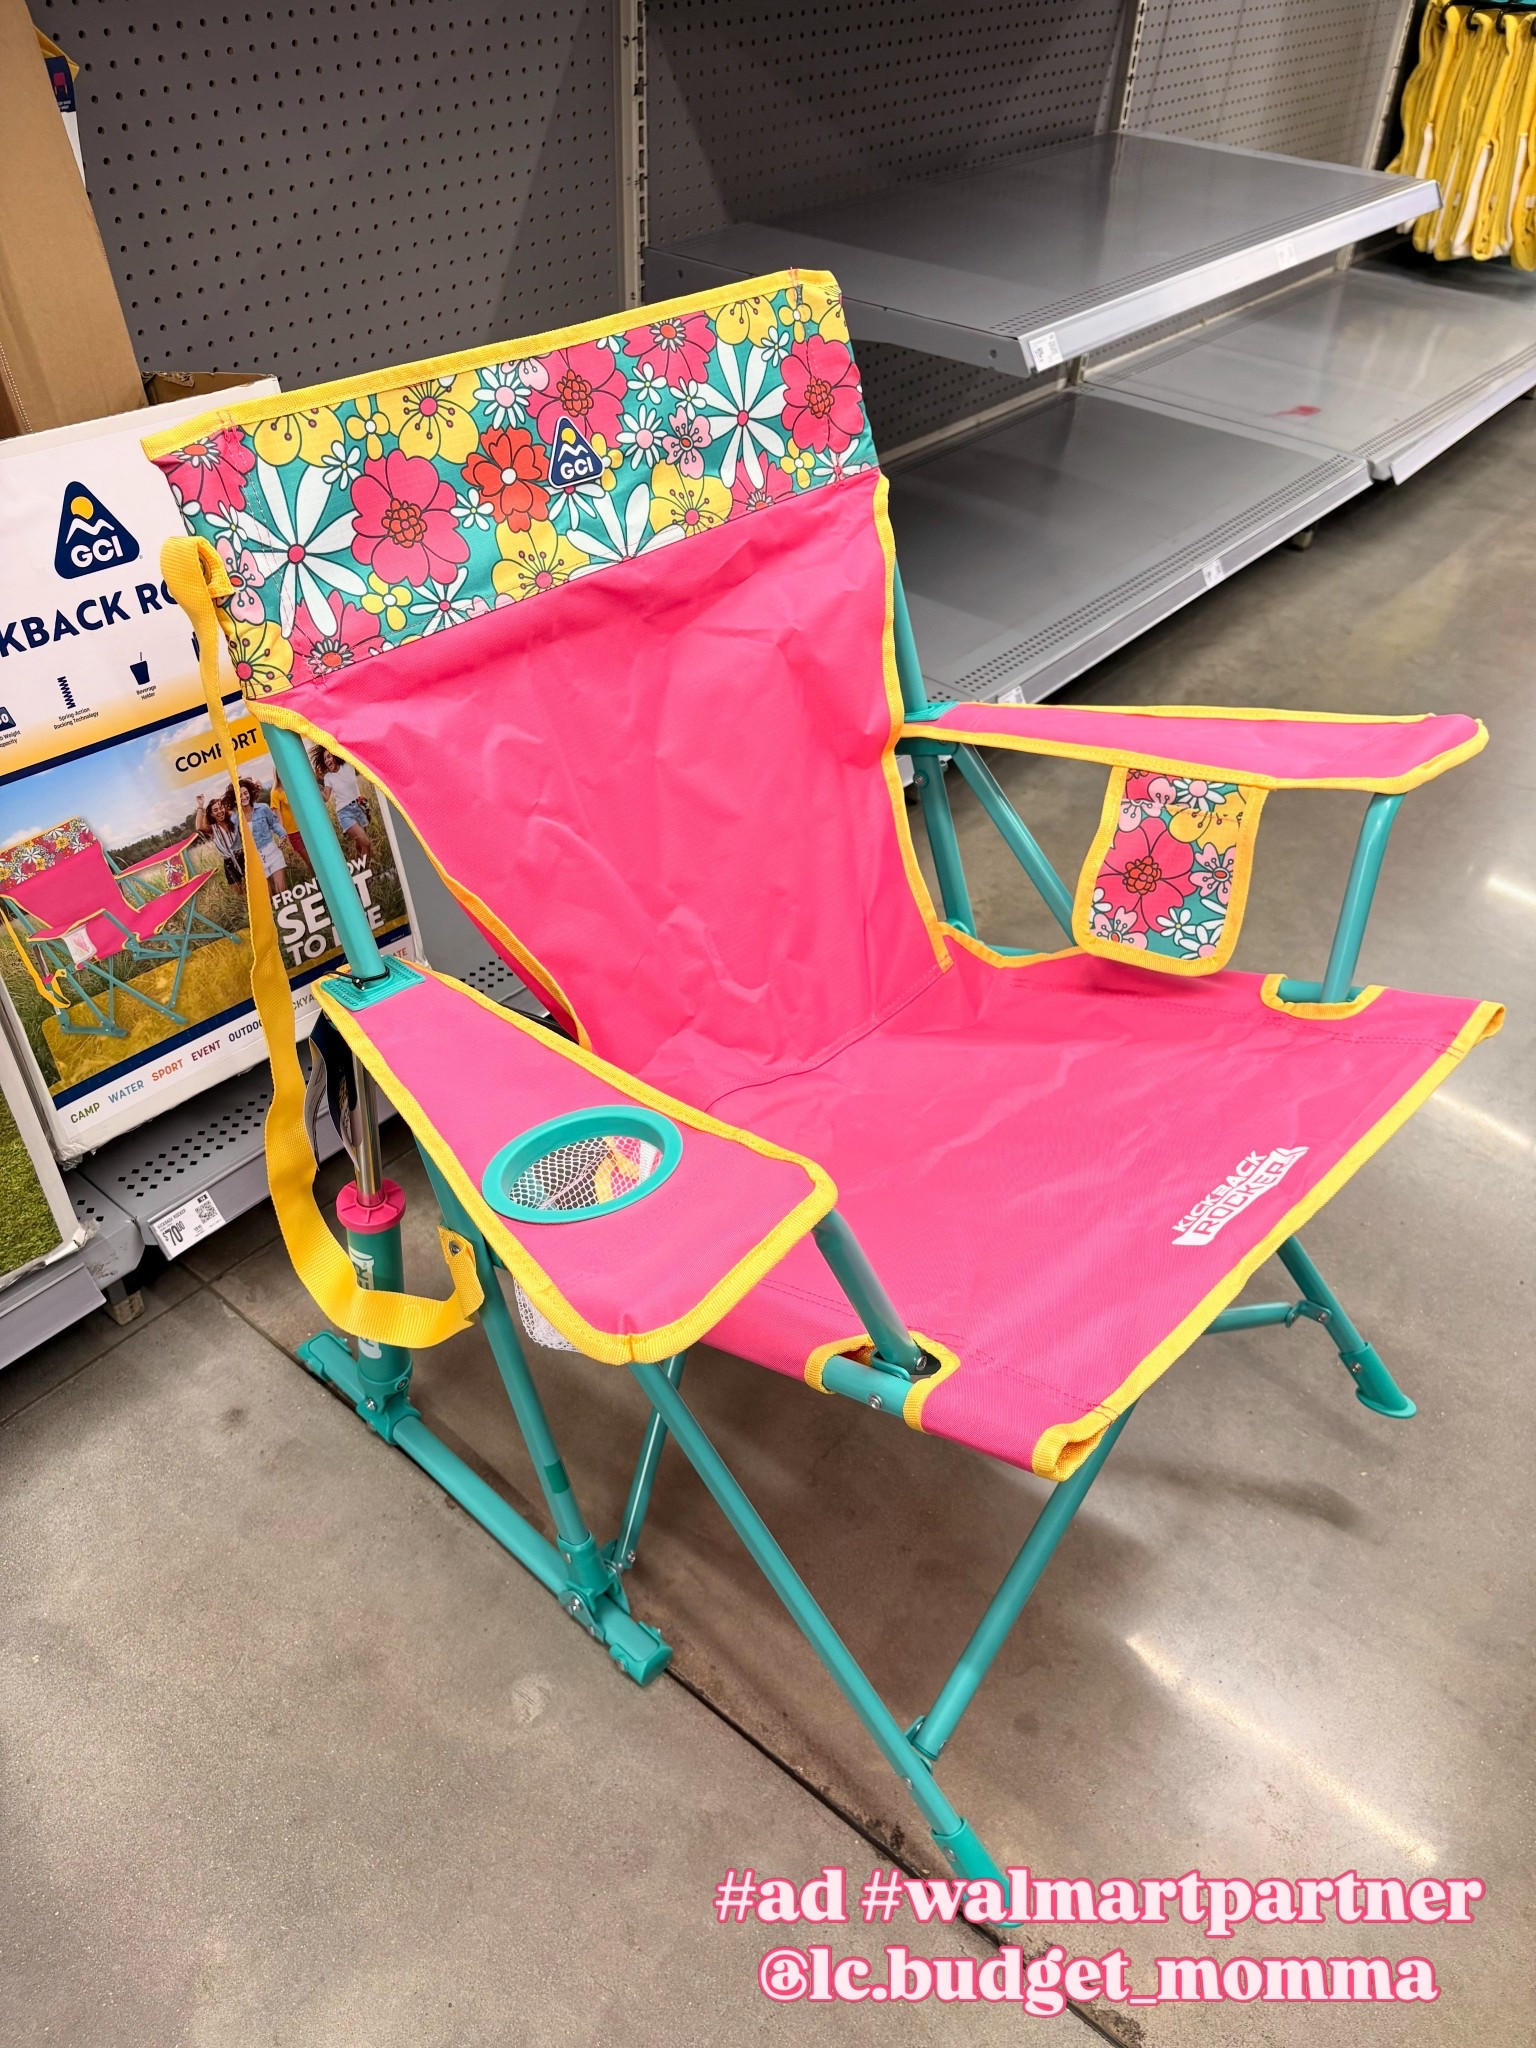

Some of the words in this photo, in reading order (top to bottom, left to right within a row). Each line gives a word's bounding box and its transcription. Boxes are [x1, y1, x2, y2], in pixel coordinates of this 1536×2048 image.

[560, 456, 594, 480] GCI
[70, 535, 124, 568] GCI
[136, 685, 157, 695] Beverage
[141, 692, 155, 700] Holder
[53, 719, 73, 730] Rocking
[73, 711, 99, 724] Technology
[58, 707, 90, 721] Spring-Action
[4, 730, 21, 739] Weight
[272, 877, 320, 910] FRON
[277, 869, 373, 945] SET
[287, 934, 327, 966] TO
[70, 1102, 100, 1124] CAMP
[108, 1080, 144, 1104] WATER
[151, 1059, 184, 1082] SPORT
[191, 1040, 222, 1062] EVENT
[1171, 1150, 1268, 1233] KICKBACK
[1193, 1160, 1286, 1236] ROCKER
